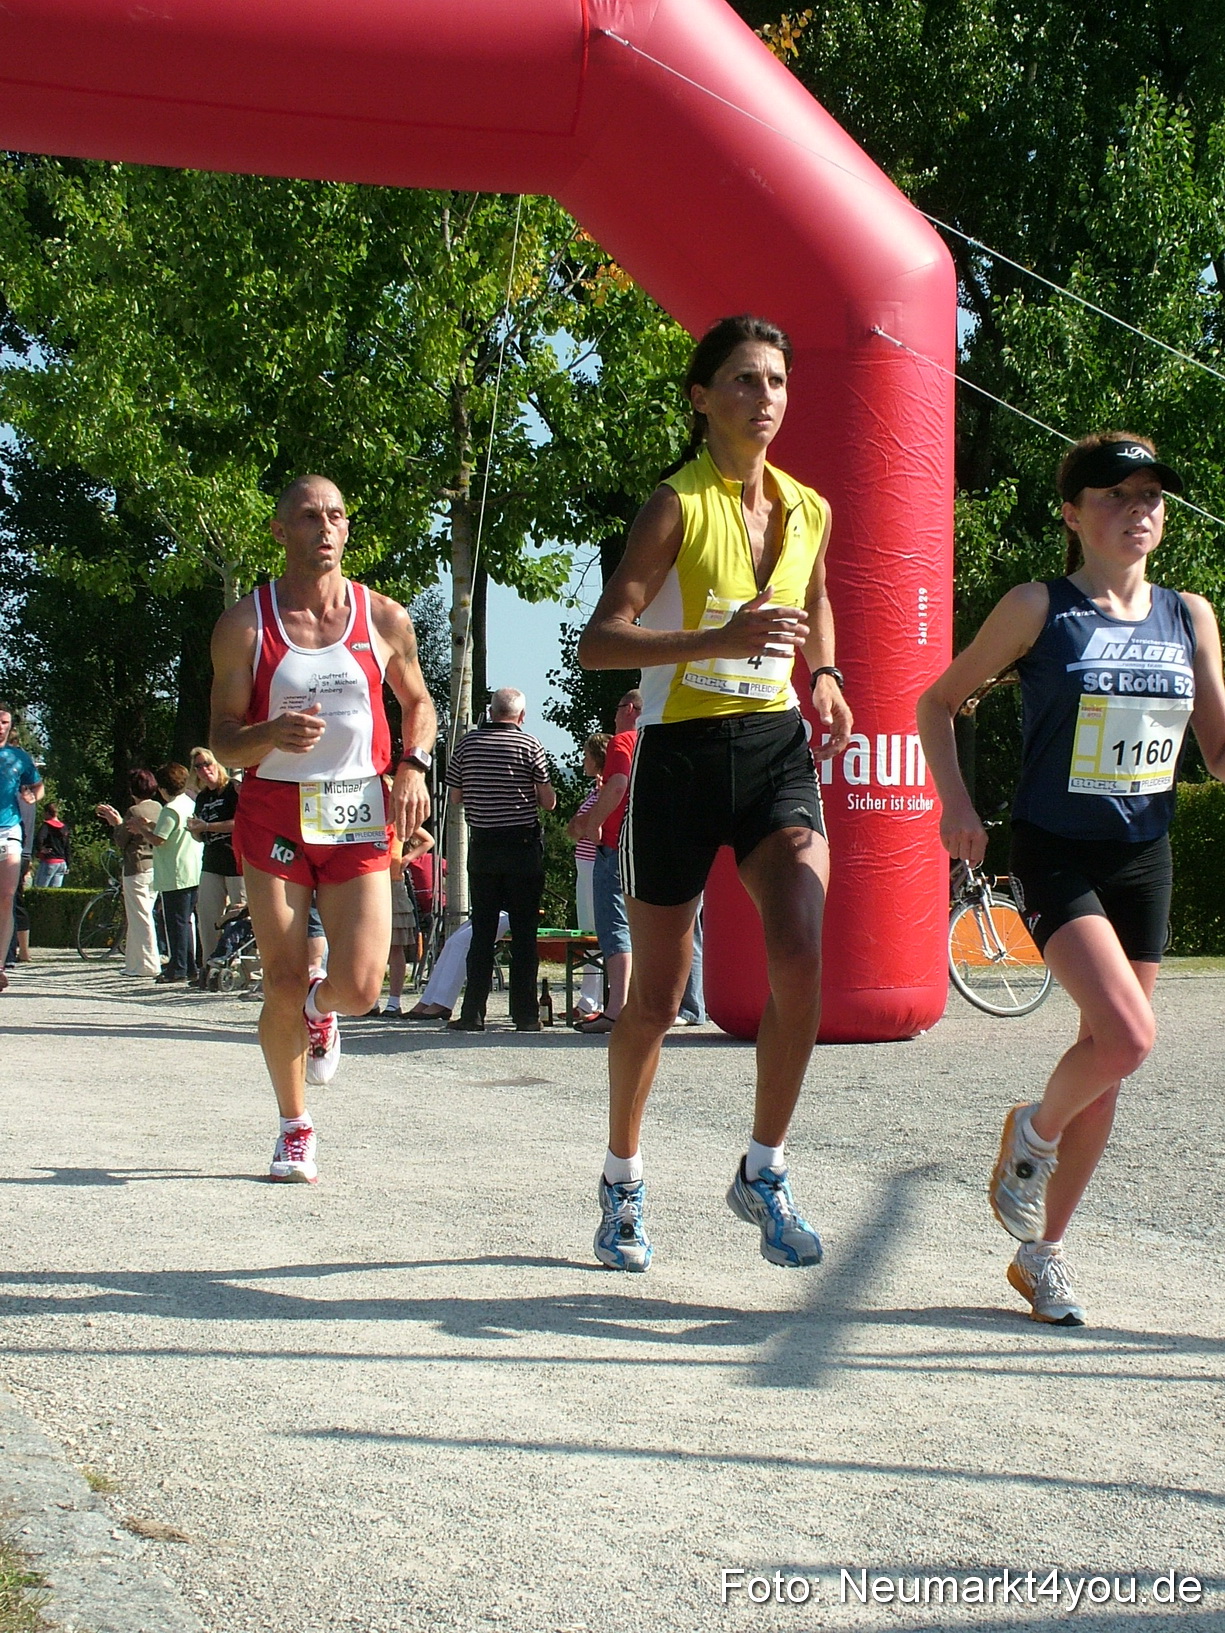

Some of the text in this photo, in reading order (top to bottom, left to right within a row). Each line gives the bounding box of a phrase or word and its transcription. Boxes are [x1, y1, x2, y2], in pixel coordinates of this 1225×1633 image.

[917, 587, 928, 645] Seit 1929
[747, 656, 762, 670] 4
[1101, 643, 1186, 664] NAGEL
[1083, 672, 1194, 697] SC Roth 52
[1112, 739, 1173, 766] 1160
[324, 781, 363, 795] Michael
[304, 803, 310, 813] A
[847, 792, 934, 811] Sicher ist sicher
[334, 804, 372, 824] 393
[270, 844, 295, 864] KP
